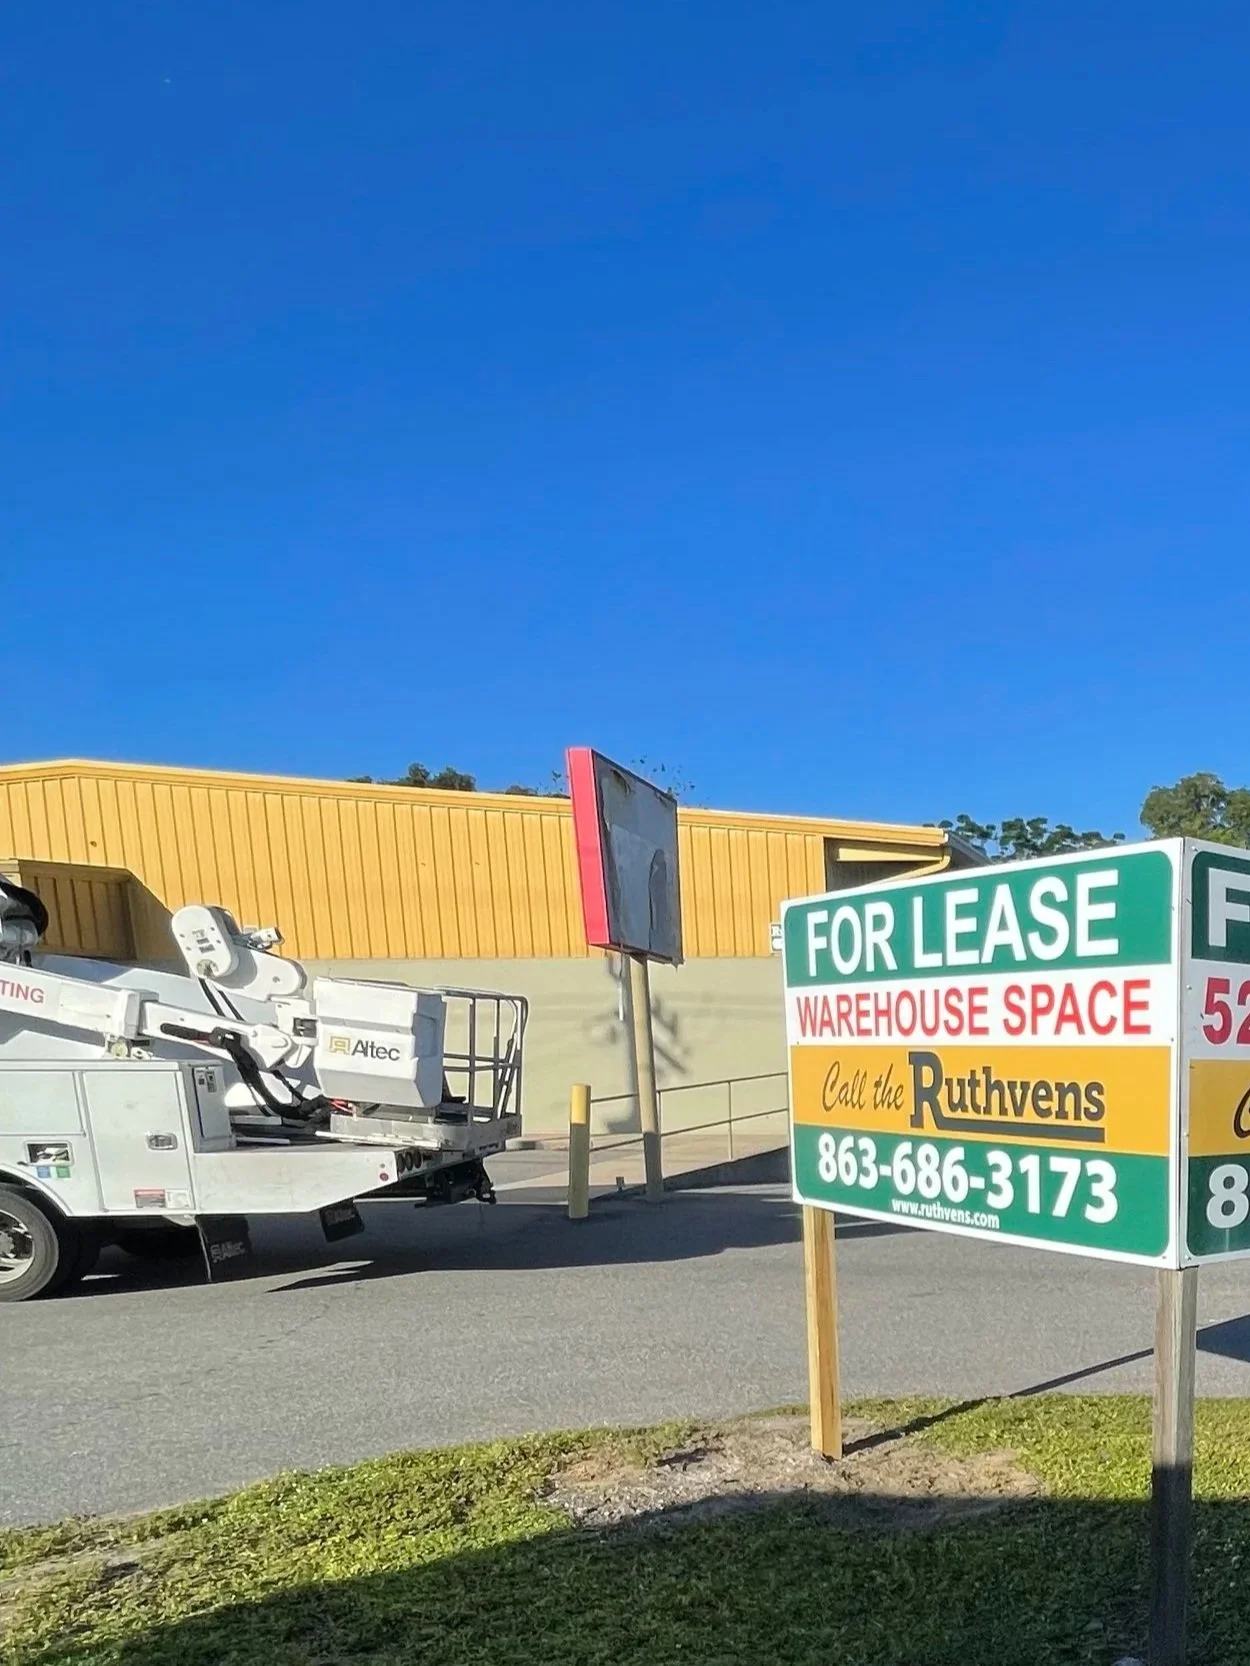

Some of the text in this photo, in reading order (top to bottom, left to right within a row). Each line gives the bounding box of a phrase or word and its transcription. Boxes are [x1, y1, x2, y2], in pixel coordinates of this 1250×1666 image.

[806, 868, 1119, 977] FOR LEASE
[797, 979, 1151, 1038] WAREHOUSE SPACE
[351, 1039, 401, 1061] Altec
[822, 1051, 1106, 1143] Call the Ruthvens
[817, 1132, 1119, 1225] 863-686-3173
[891, 1198, 1000, 1230] www.ruthvens.com
